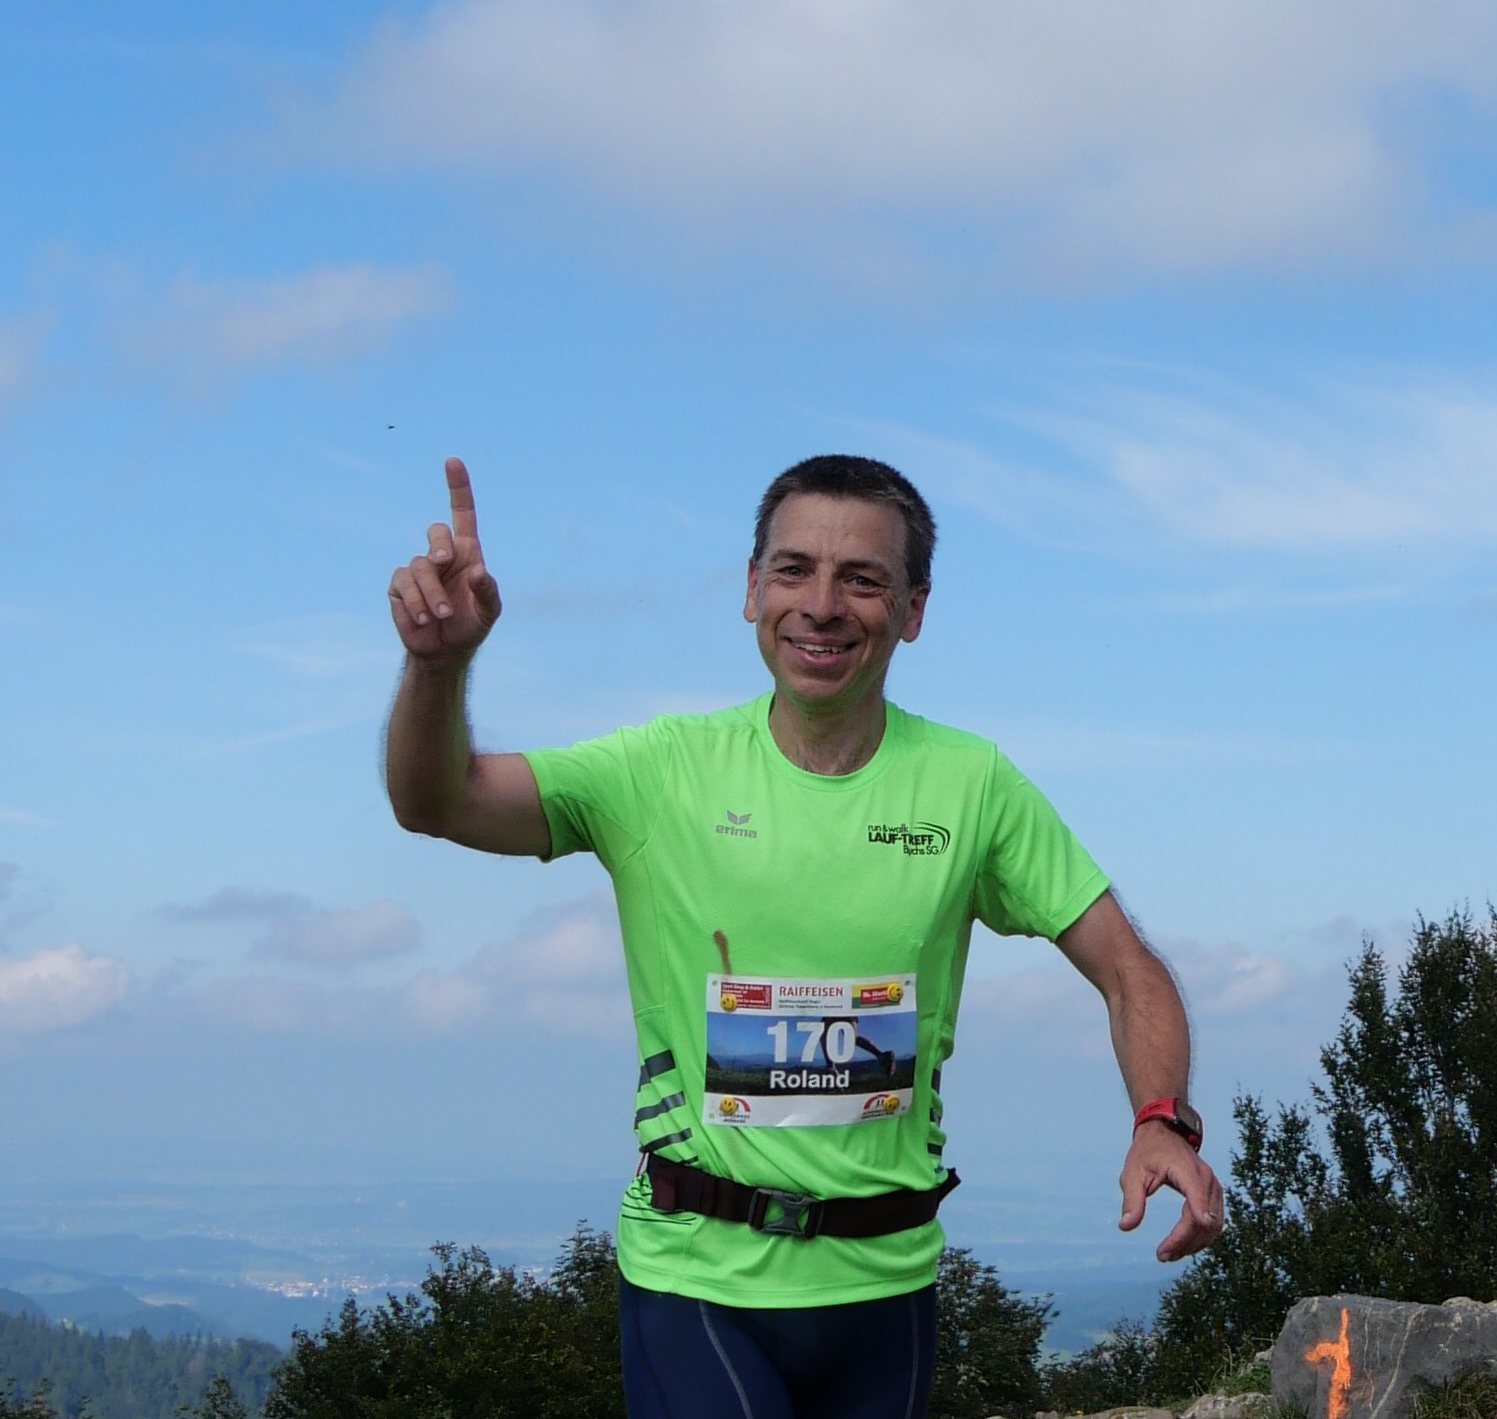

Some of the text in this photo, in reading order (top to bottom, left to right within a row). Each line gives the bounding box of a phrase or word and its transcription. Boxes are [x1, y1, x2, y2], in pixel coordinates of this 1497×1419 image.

[716, 823, 757, 838] erima
[868, 832, 934, 845] LAUF-TREFF
[926, 845, 939, 855] SG
[779, 986, 843, 998] RAIFFEISEN
[767, 1020, 856, 1064] 170
[770, 1070, 850, 1089] Roland
